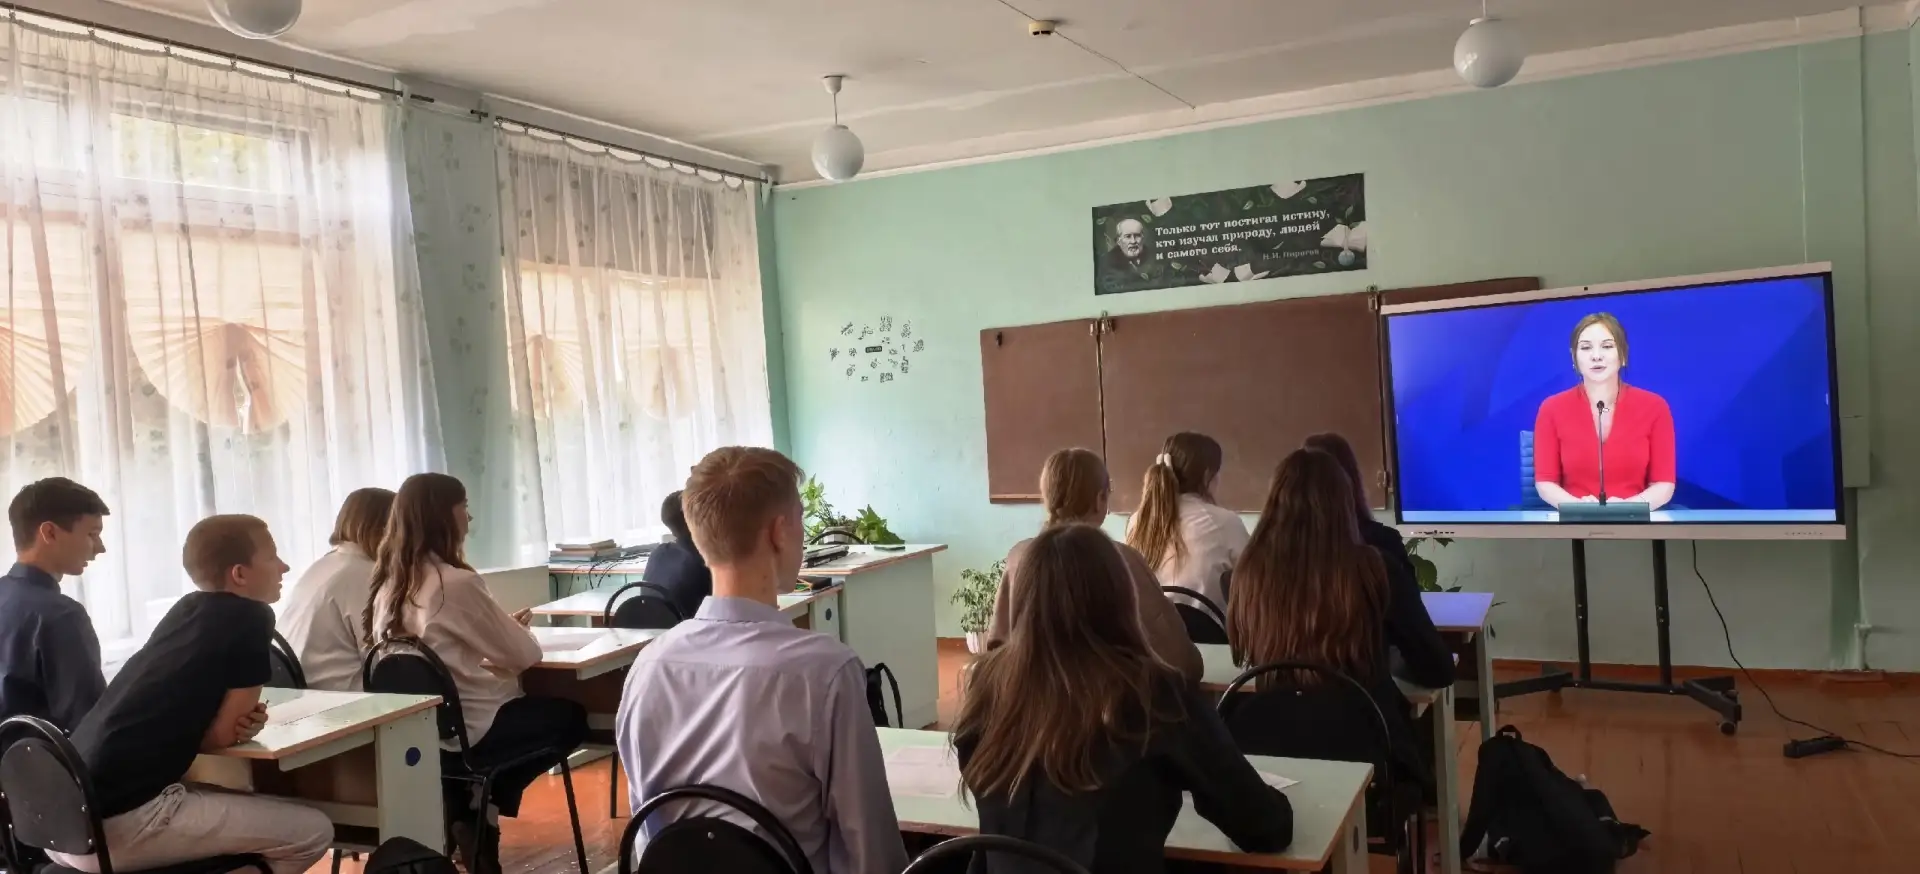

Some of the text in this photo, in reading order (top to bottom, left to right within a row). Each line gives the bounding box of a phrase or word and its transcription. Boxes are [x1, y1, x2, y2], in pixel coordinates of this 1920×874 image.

[1155, 209, 1330, 236] Только тот постигал истину,
[1155, 220, 1320, 248] кто изучал природу, людей
[1155, 242, 1242, 260] и самого себя.
